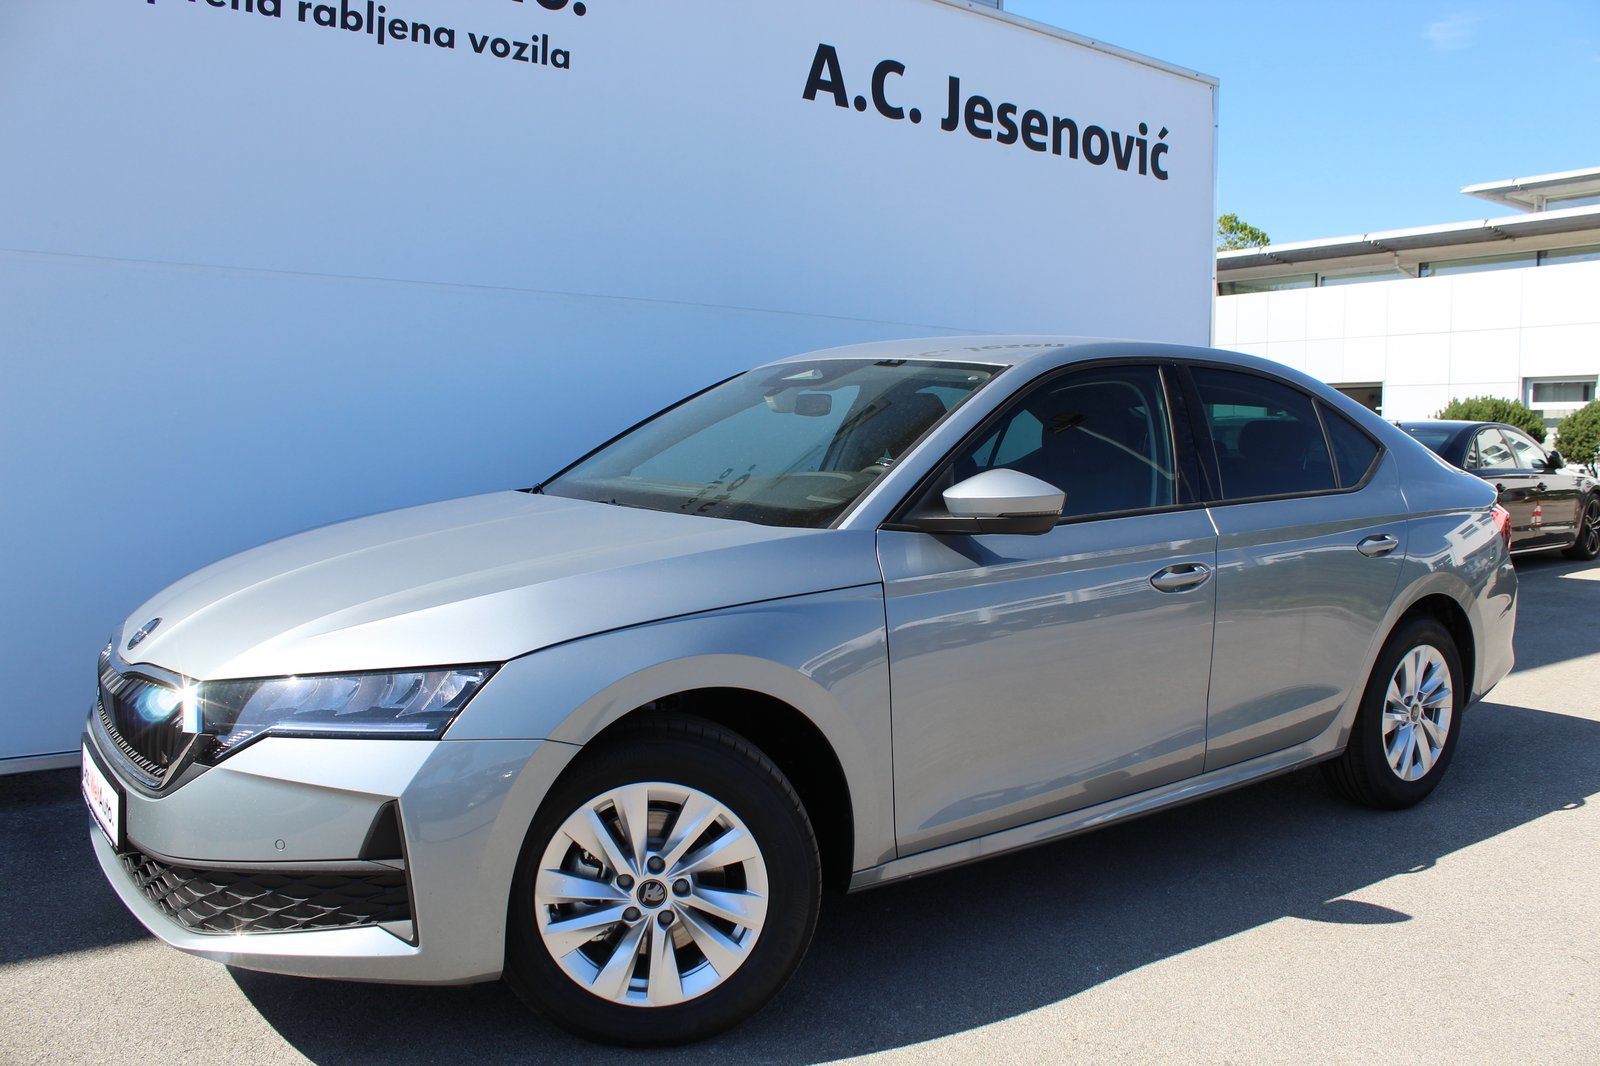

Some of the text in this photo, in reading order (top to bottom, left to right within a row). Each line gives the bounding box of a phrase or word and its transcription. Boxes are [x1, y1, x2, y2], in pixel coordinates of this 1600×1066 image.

[298, 0, 456, 49] rabljena
[467, 33, 570, 70] vozila
[802, 43, 1169, 181] A.C. Jesenović
